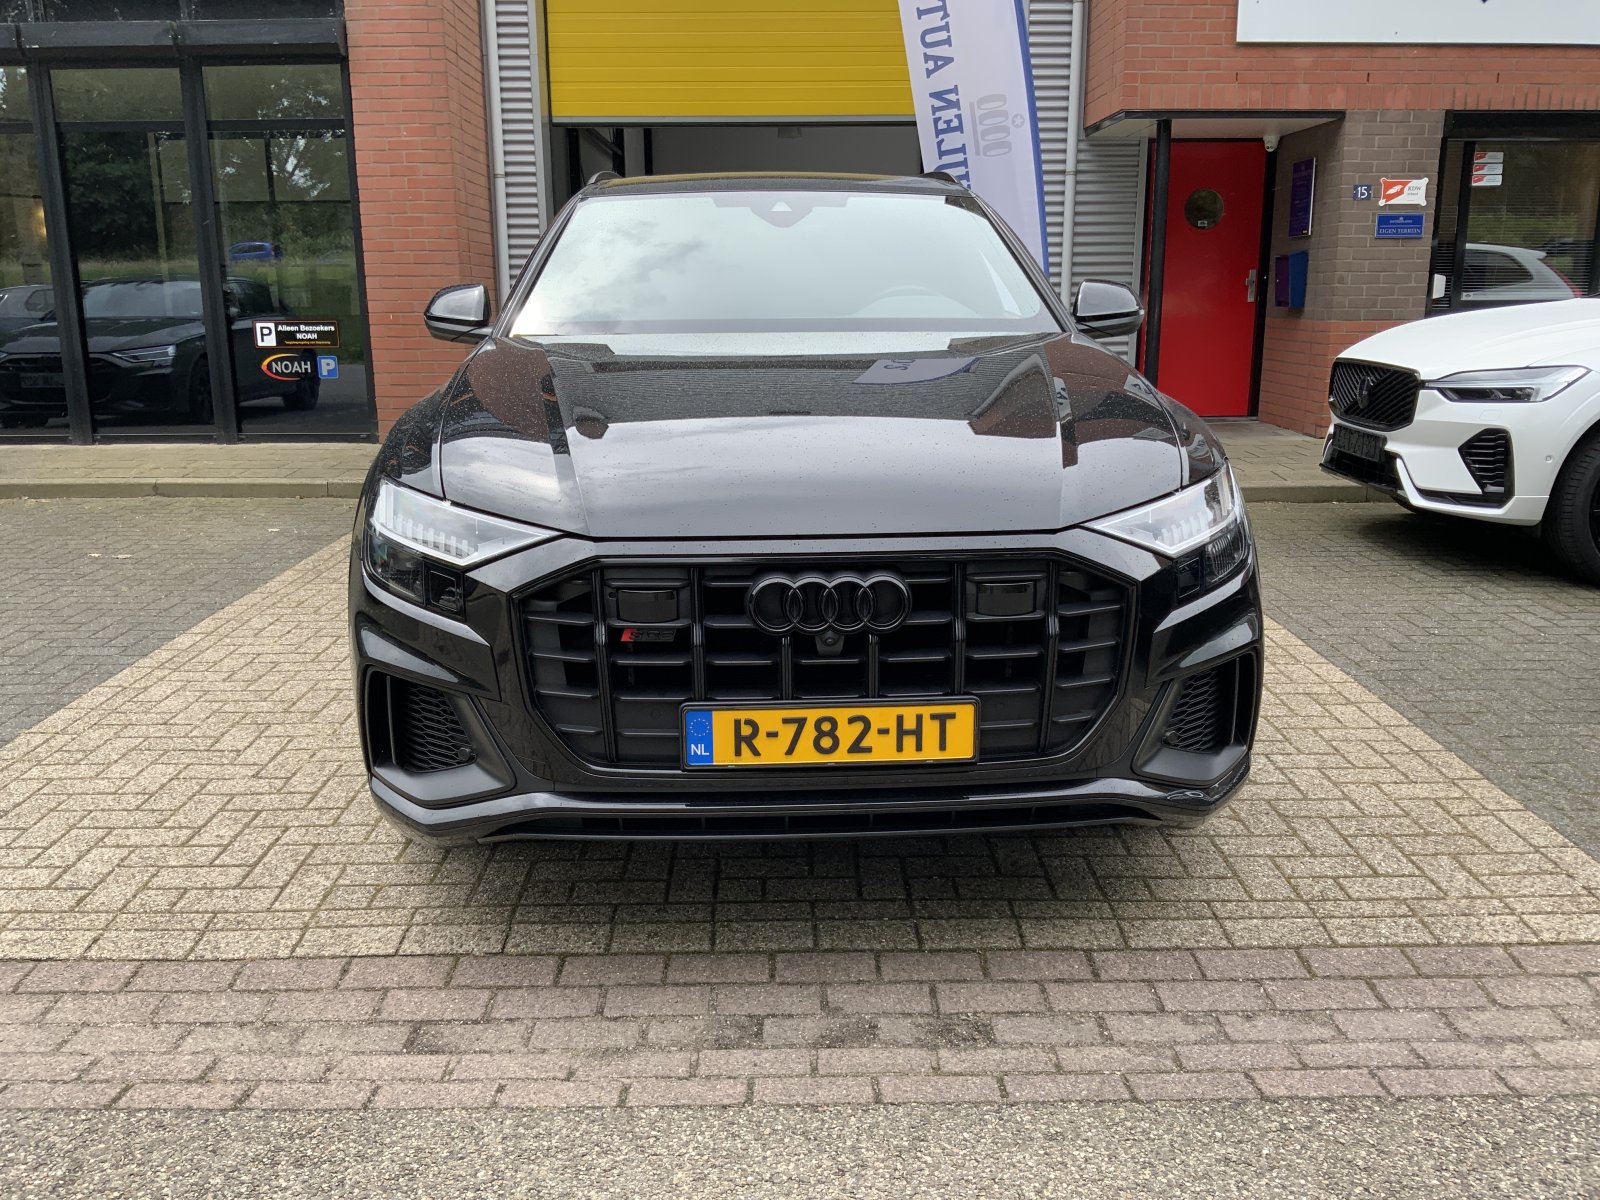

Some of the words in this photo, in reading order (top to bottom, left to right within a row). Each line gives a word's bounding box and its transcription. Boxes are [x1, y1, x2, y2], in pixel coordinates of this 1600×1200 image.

[1357, 186, 1368, 198] 15
[260, 326, 272, 342] P
[271, 361, 311, 373] NOAH
[320, 359, 335, 375] P
[733, 711, 956, 757] R-782-HT
[690, 743, 710, 756] NL
